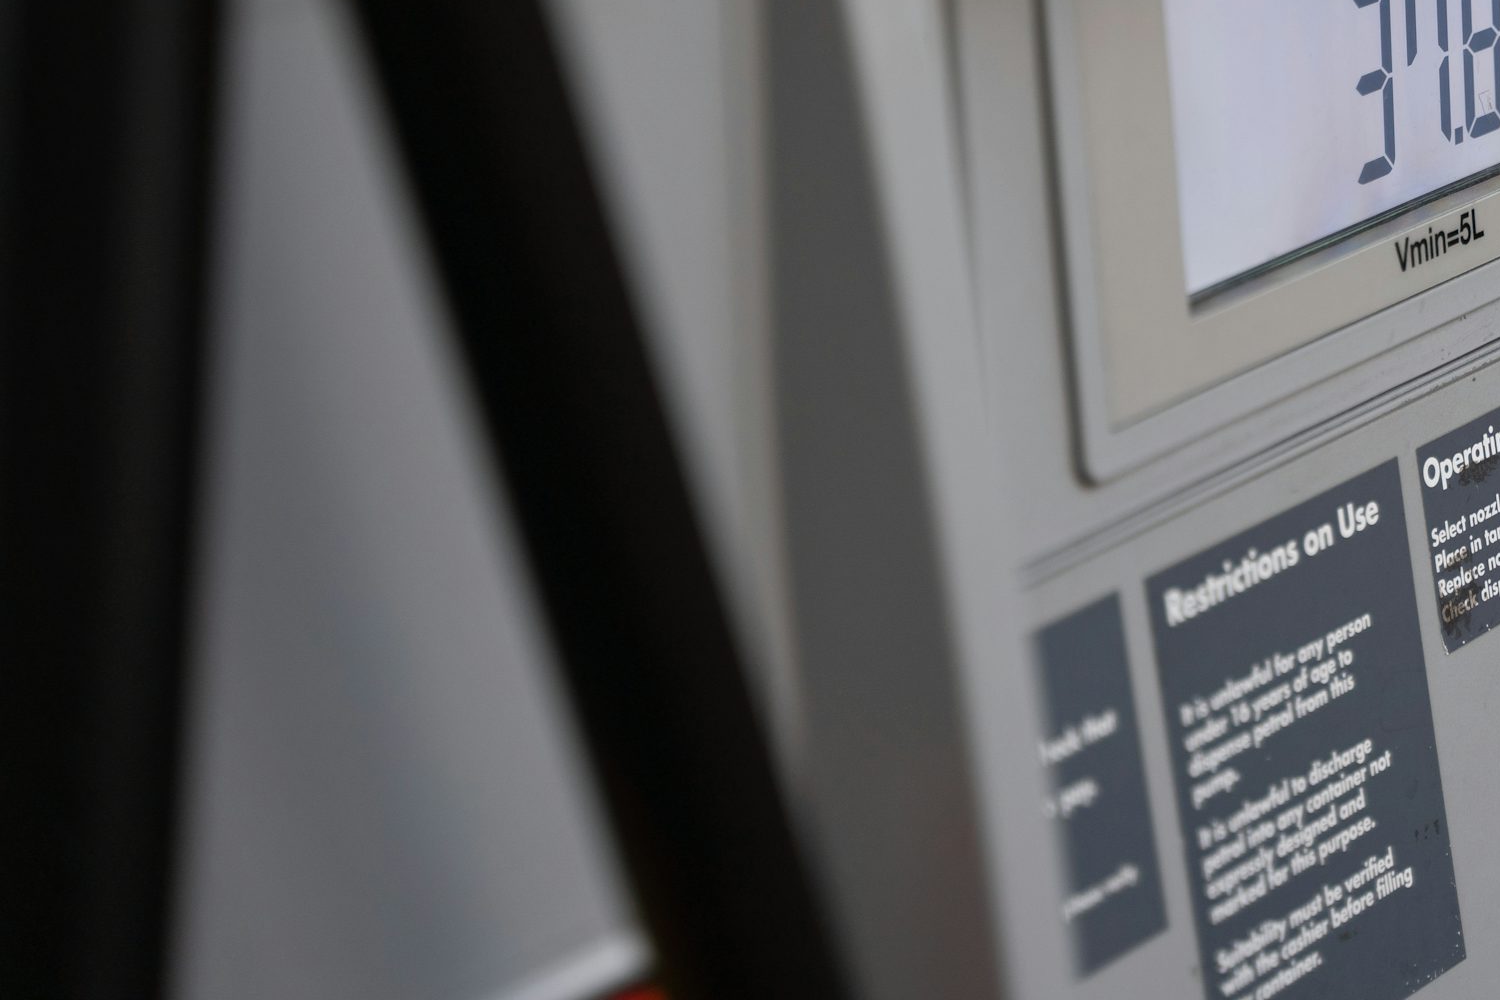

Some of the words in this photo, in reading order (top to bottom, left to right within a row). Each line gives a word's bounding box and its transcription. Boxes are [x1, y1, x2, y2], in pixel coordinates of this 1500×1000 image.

[1395, 208, 1485, 273] Vmin=5L
[1164, 539, 1299, 627] Restrictions
[1304, 523, 1334, 556] on
[1337, 501, 1379, 538] Use
[1432, 515, 1467, 547] Select
[1435, 547, 1467, 573] Place
[1470, 535, 1482, 554] in
[1438, 564, 1485, 598] Replace
[1442, 592, 1478, 623] Check
[1274, 653, 1295, 676] for
[1297, 638, 1323, 663] any
[1326, 613, 1371, 654] person
[1252, 683, 1291, 721] years
[1293, 667, 1308, 692] of
[1310, 658, 1336, 684] age
[1338, 650, 1353, 668] to
[1253, 702, 1294, 748] petrol
[1295, 690, 1328, 718] from
[1330, 673, 1355, 699] this
[1277, 804, 1304, 831] any
[1306, 767, 1366, 814] container
[1370, 750, 1391, 776] not
[1291, 776, 1307, 796] to
[1309, 738, 1372, 785] discharge
[1267, 864, 1289, 890] for
[1290, 847, 1316, 875] this
[1318, 816, 1376, 866] purpose.
[1277, 805, 1337, 858] designed
[1339, 787, 1365, 820] and
[1281, 918, 1328, 960] cashier
[1330, 892, 1375, 929] before
[1376, 866, 1413, 899] filling
[1289, 894, 1323, 929] must
[1324, 885, 1343, 906] be
[1344, 846, 1394, 892] verified
[1256, 952, 1322, 1000] container.
